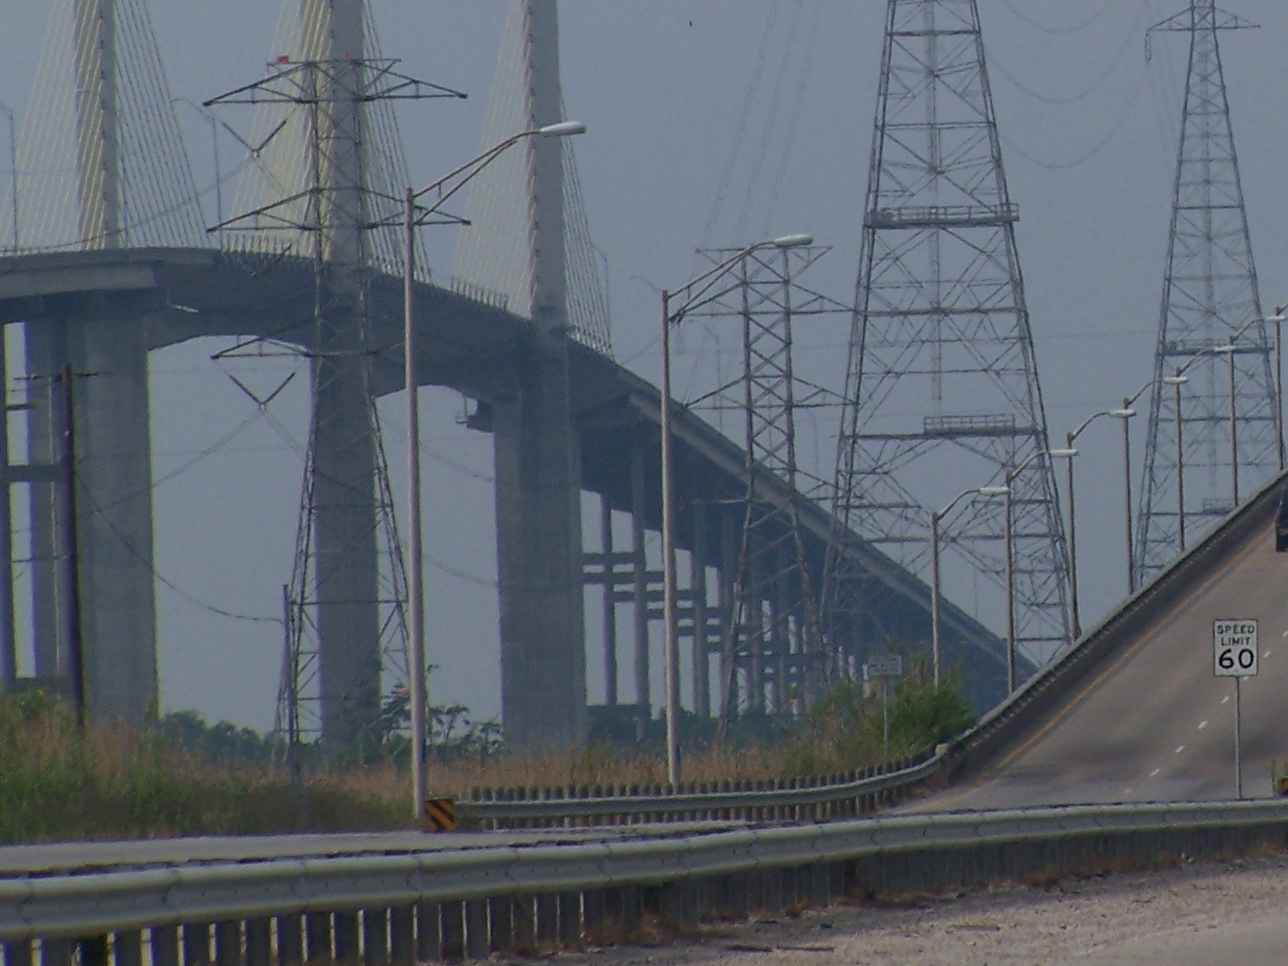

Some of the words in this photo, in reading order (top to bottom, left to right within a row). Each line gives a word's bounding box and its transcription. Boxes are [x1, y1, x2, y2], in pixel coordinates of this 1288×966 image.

[1216, 624, 1255, 635] SPEED
[1220, 636, 1251, 646] LIMIT
[1218, 648, 1255, 669] 60
